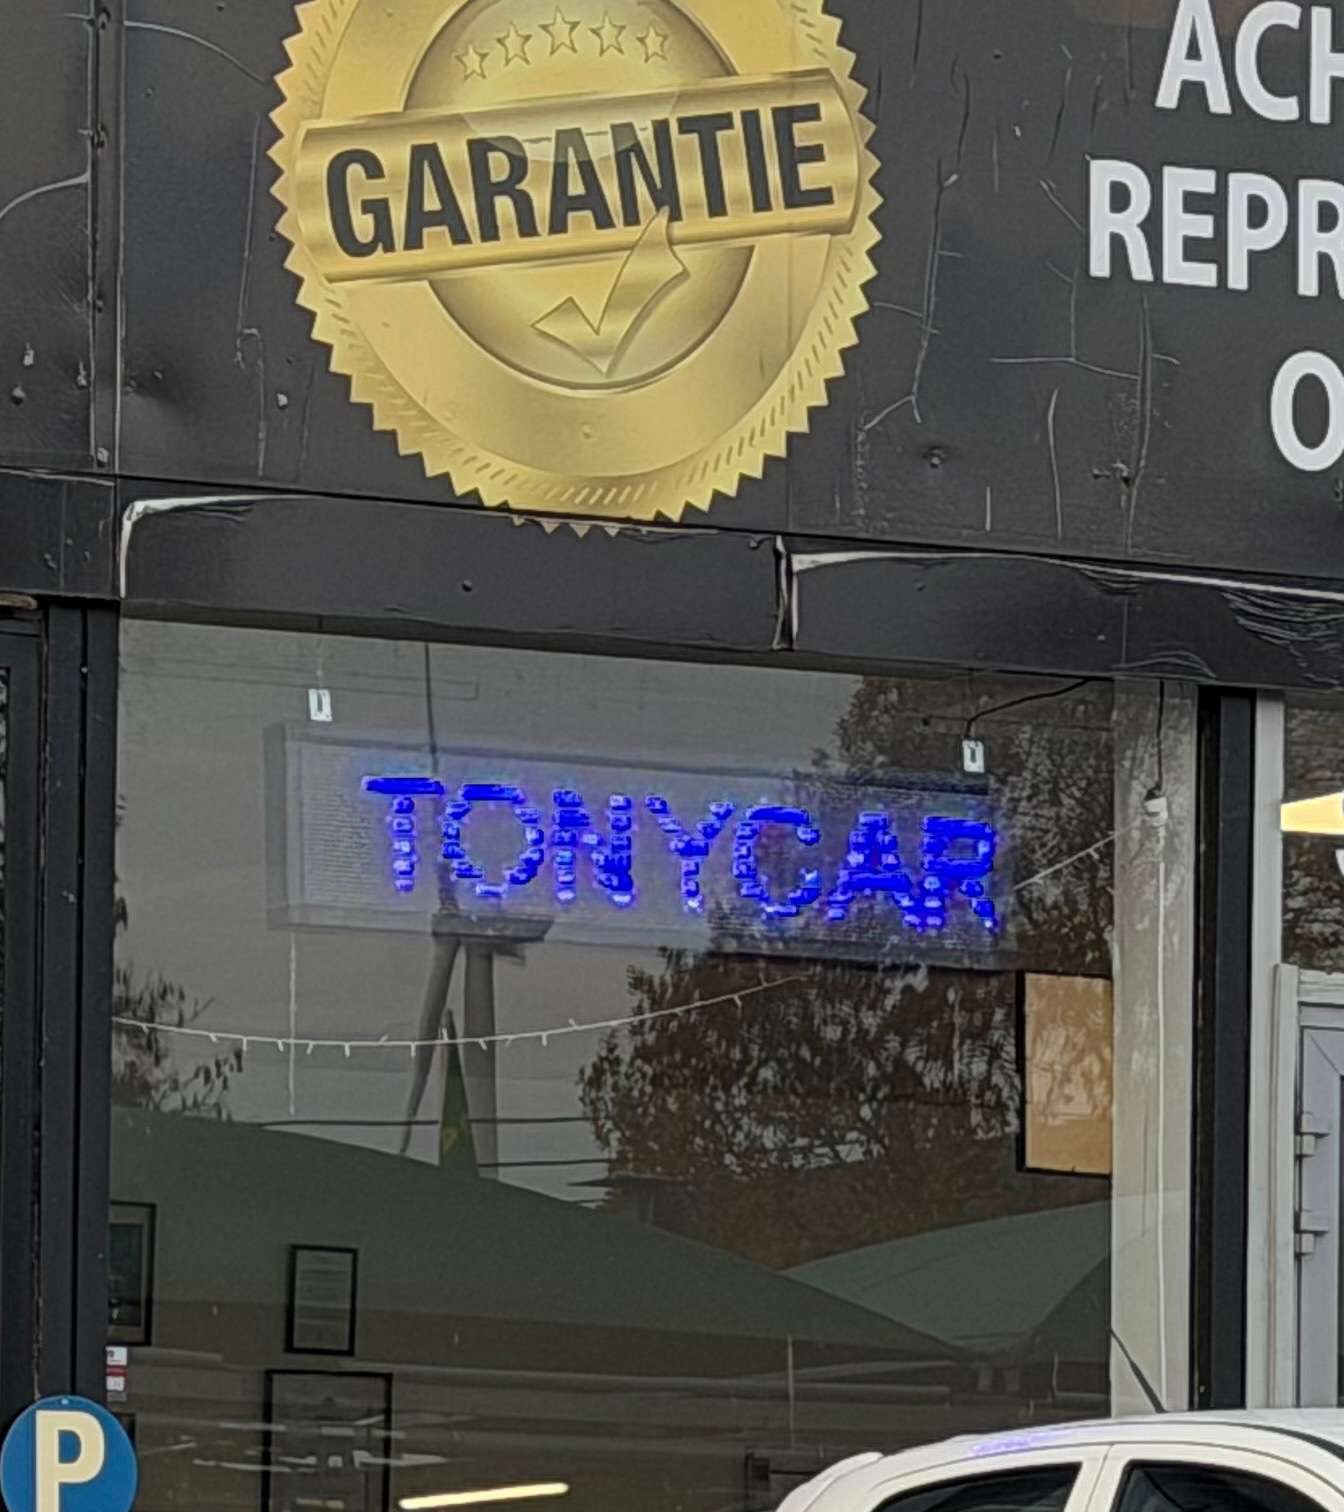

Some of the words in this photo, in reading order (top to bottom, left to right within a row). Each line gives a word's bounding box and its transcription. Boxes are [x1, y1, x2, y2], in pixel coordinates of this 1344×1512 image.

[324, 102, 836, 259] GARANTIE
[1088, 158, 1344, 300] REPR
[362, 775, 999, 931] TONYCAR
